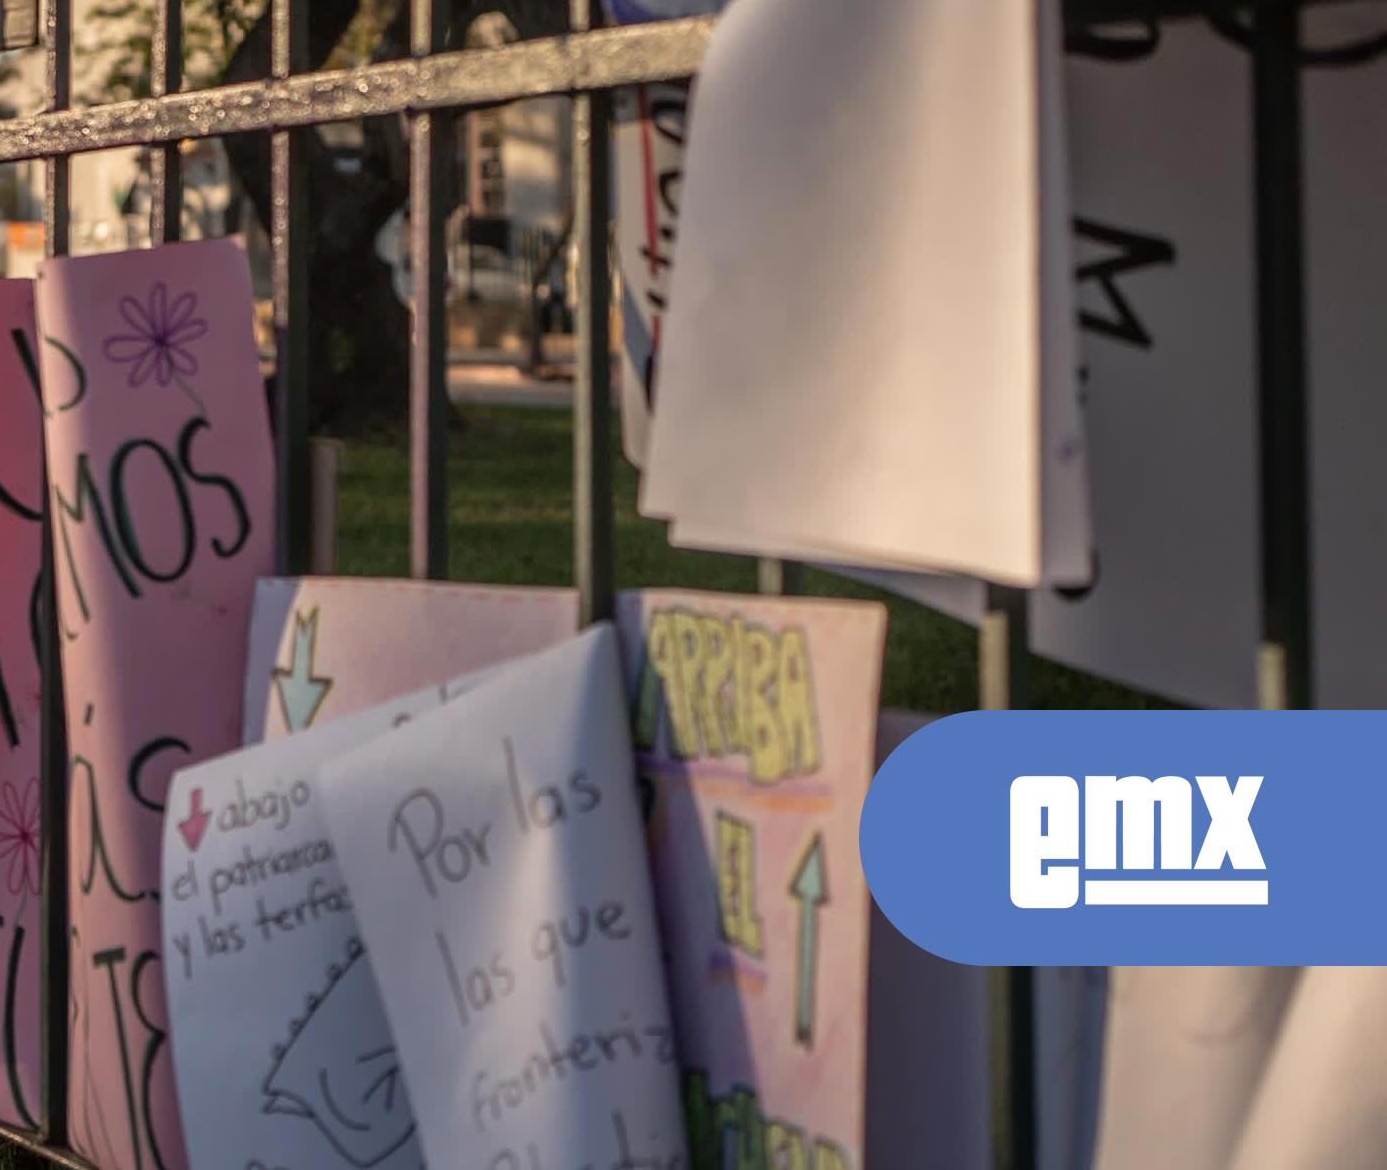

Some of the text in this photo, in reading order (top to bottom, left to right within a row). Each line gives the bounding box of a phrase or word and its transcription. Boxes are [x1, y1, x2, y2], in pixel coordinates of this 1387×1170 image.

[386, 733, 603, 899] Por las
[529, 898, 632, 990] que
